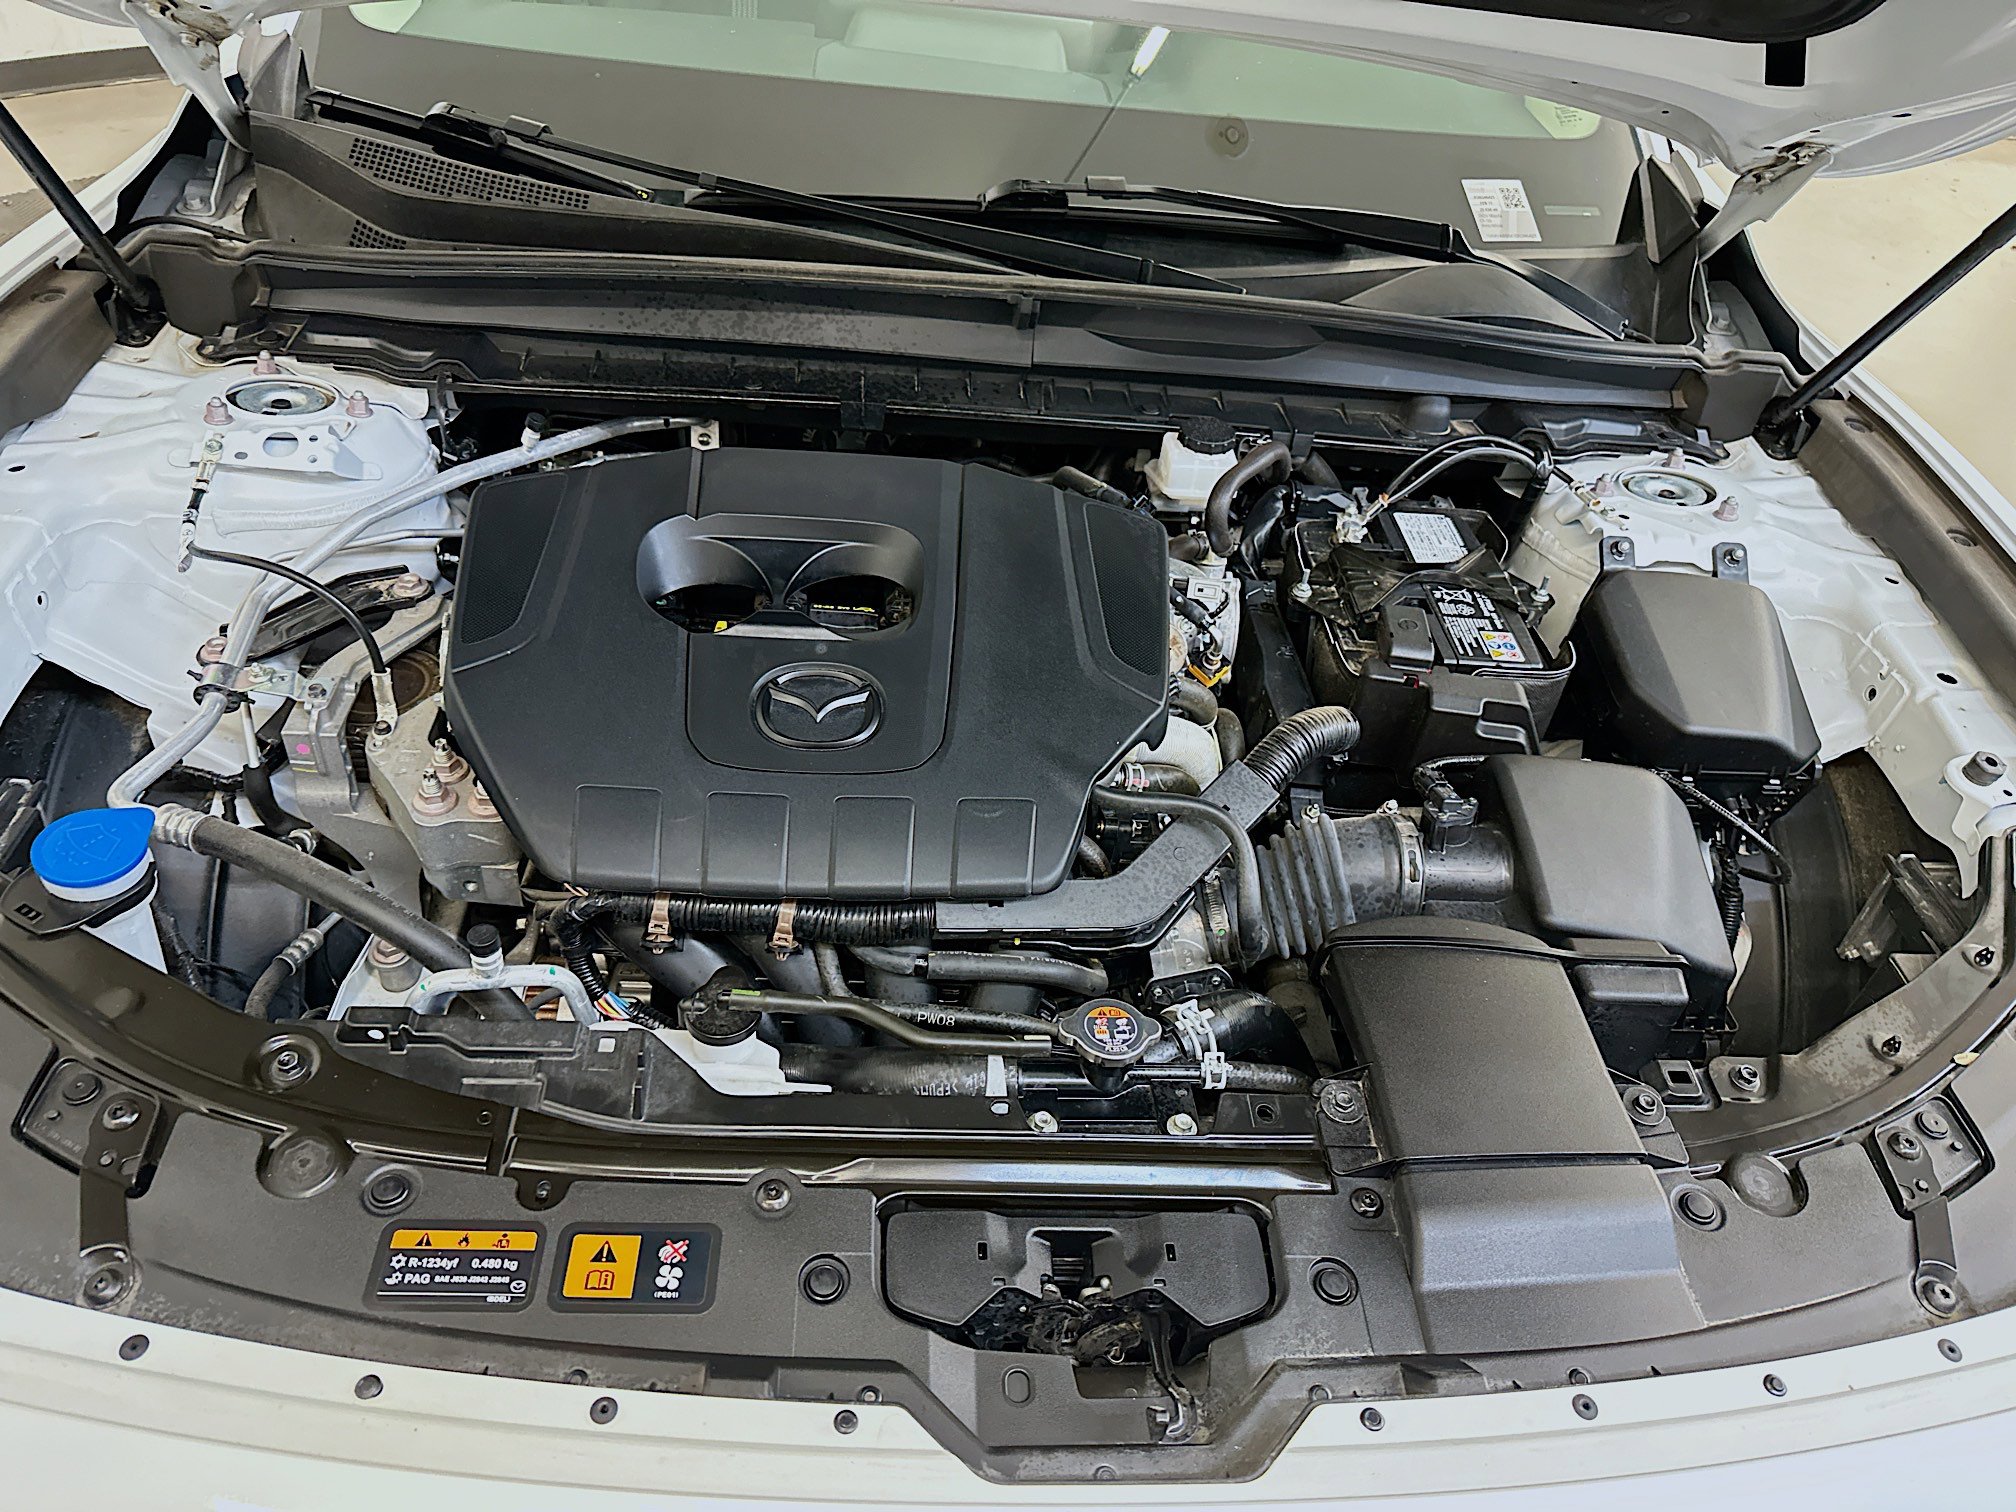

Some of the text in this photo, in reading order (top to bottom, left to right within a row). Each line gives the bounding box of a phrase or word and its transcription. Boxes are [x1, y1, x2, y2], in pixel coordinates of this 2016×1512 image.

[407, 1257, 460, 1271] R-1234yf
[502, 1258, 519, 1272] kg
[403, 1273, 431, 1285] PAG
